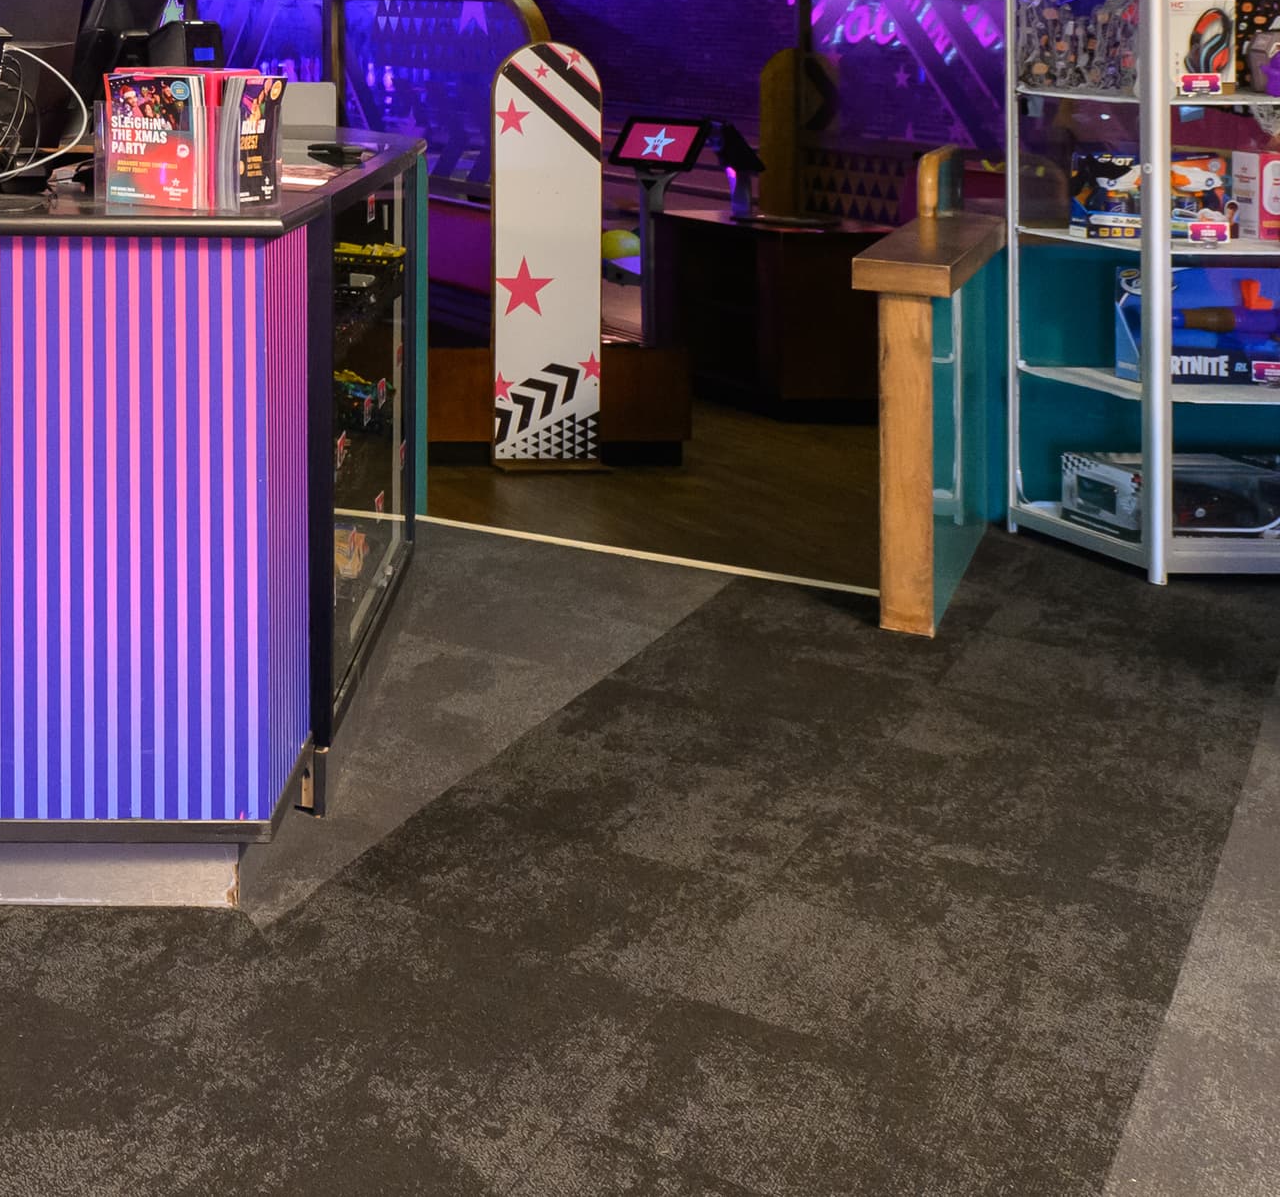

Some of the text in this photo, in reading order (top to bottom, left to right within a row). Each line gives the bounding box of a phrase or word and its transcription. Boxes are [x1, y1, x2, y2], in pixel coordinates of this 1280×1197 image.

[111, 127, 168, 144] THE XMAS
[111, 141, 147, 156] PARTY
[1171, 354, 1230, 378] RTNITE
